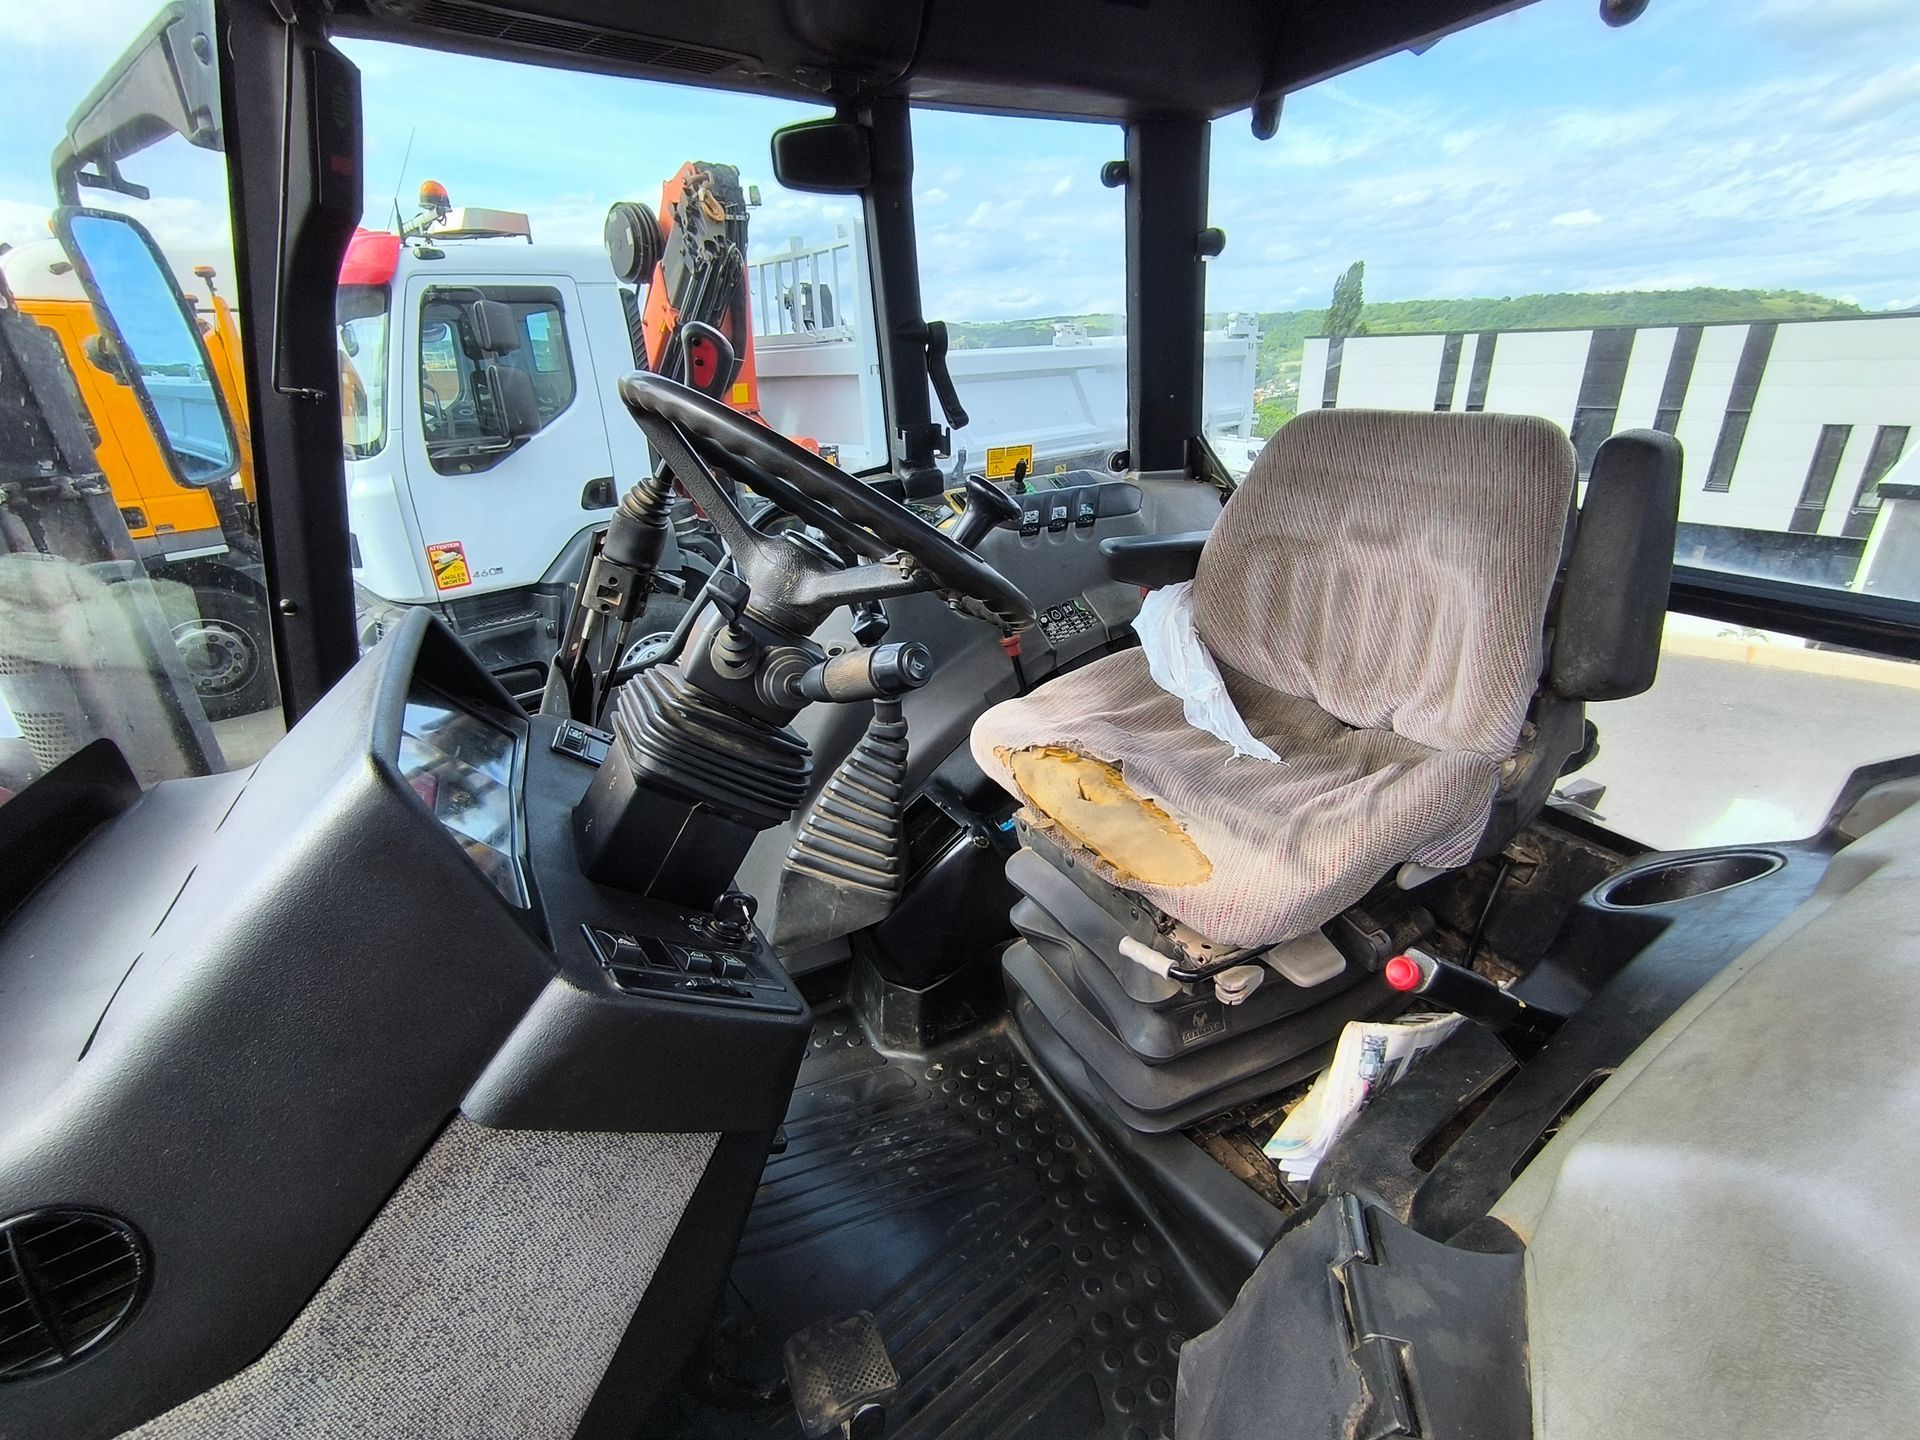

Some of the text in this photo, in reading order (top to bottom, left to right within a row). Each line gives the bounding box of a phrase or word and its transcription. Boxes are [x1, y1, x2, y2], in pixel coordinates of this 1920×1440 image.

[429, 542, 460, 551] ATTENTION
[440, 572, 466, 581] ANGLES
[473, 568, 496, 578] 460
[443, 578, 466, 586] MORTS
